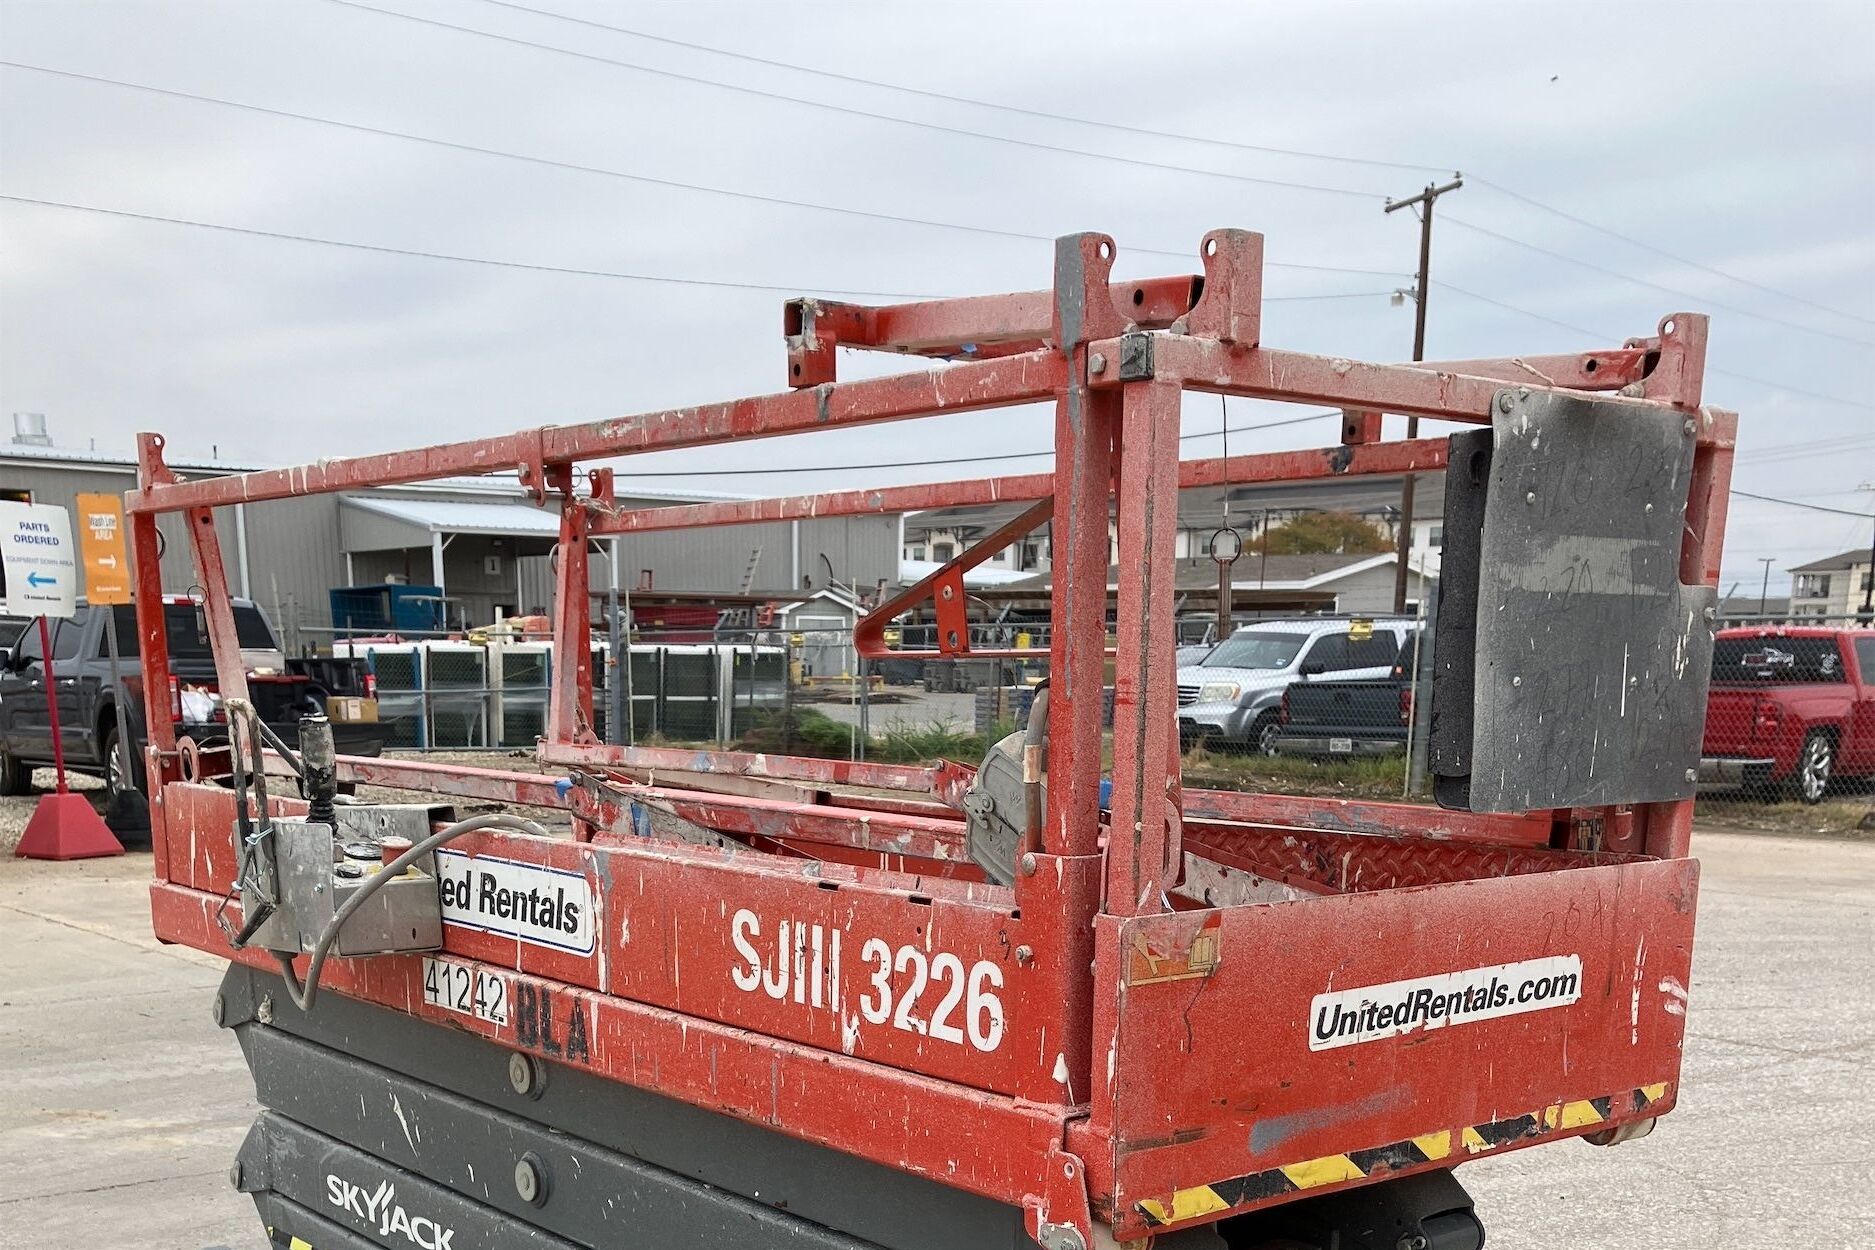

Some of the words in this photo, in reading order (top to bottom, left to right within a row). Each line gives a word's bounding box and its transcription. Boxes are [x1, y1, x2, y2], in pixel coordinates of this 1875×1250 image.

[14, 534, 59, 545] ORDERED
[19, 522, 49, 532] PARTS
[479, 872, 580, 934] Rentals
[860, 938, 1004, 1053] 3226
[1316, 972, 1577, 1040] UnitedRentals.com
